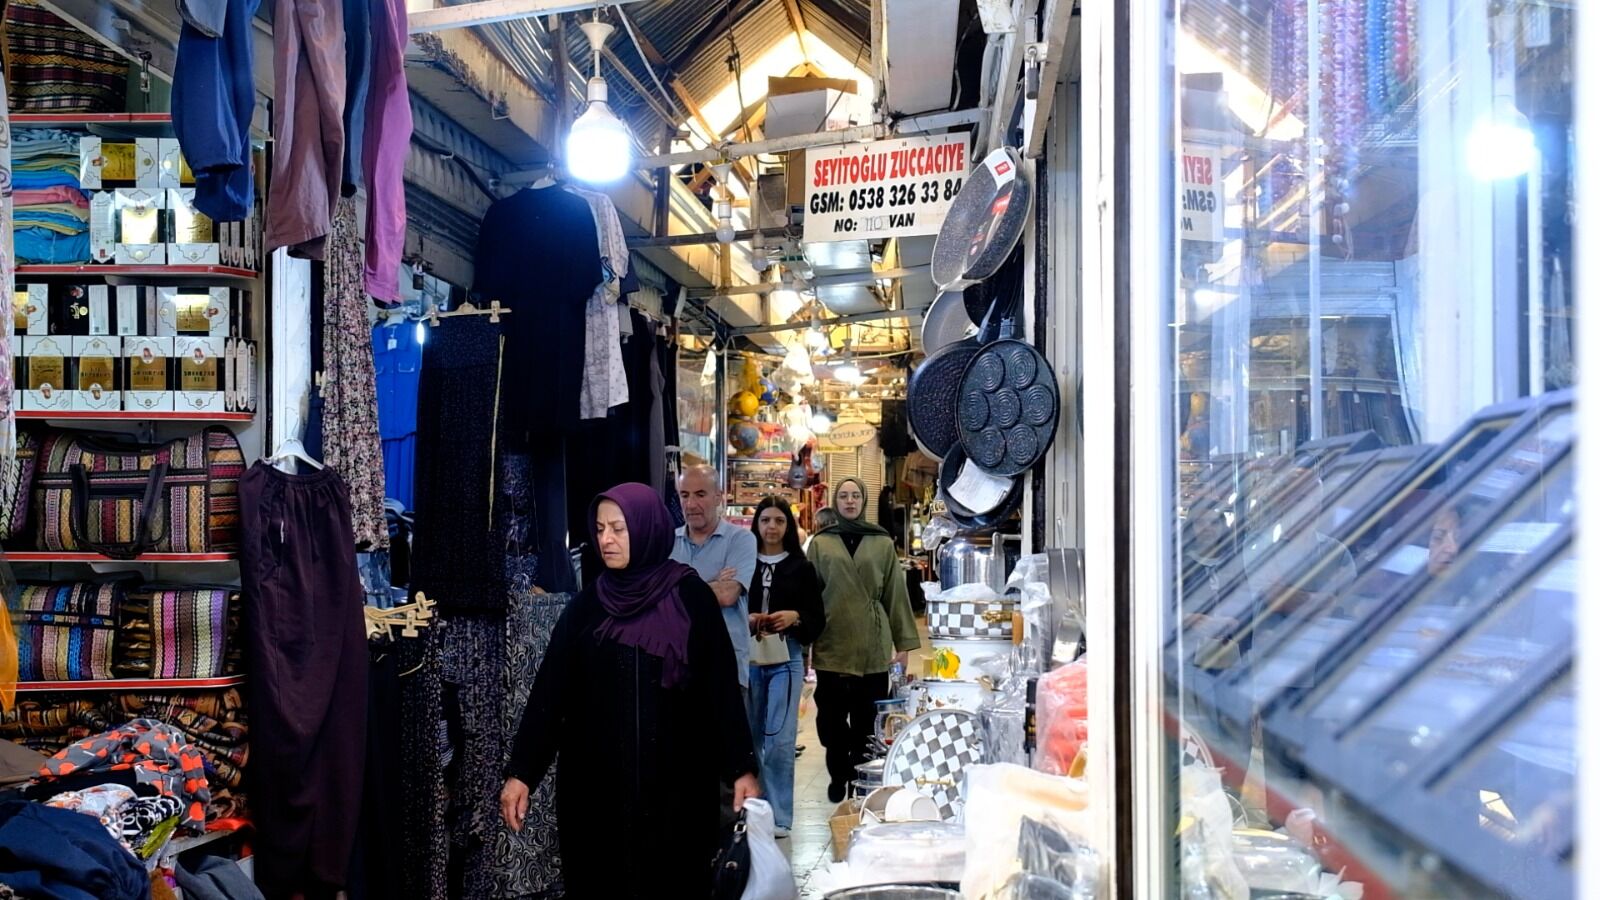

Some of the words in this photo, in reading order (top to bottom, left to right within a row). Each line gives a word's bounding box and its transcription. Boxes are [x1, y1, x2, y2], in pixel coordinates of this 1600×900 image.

[810, 191, 844, 214] GSM:
[849, 186, 884, 211] 0538
[889, 183, 917, 206] 326
[921, 180, 939, 203] 33
[834, 218, 858, 232] NO:
[889, 213, 915, 228] VAN
